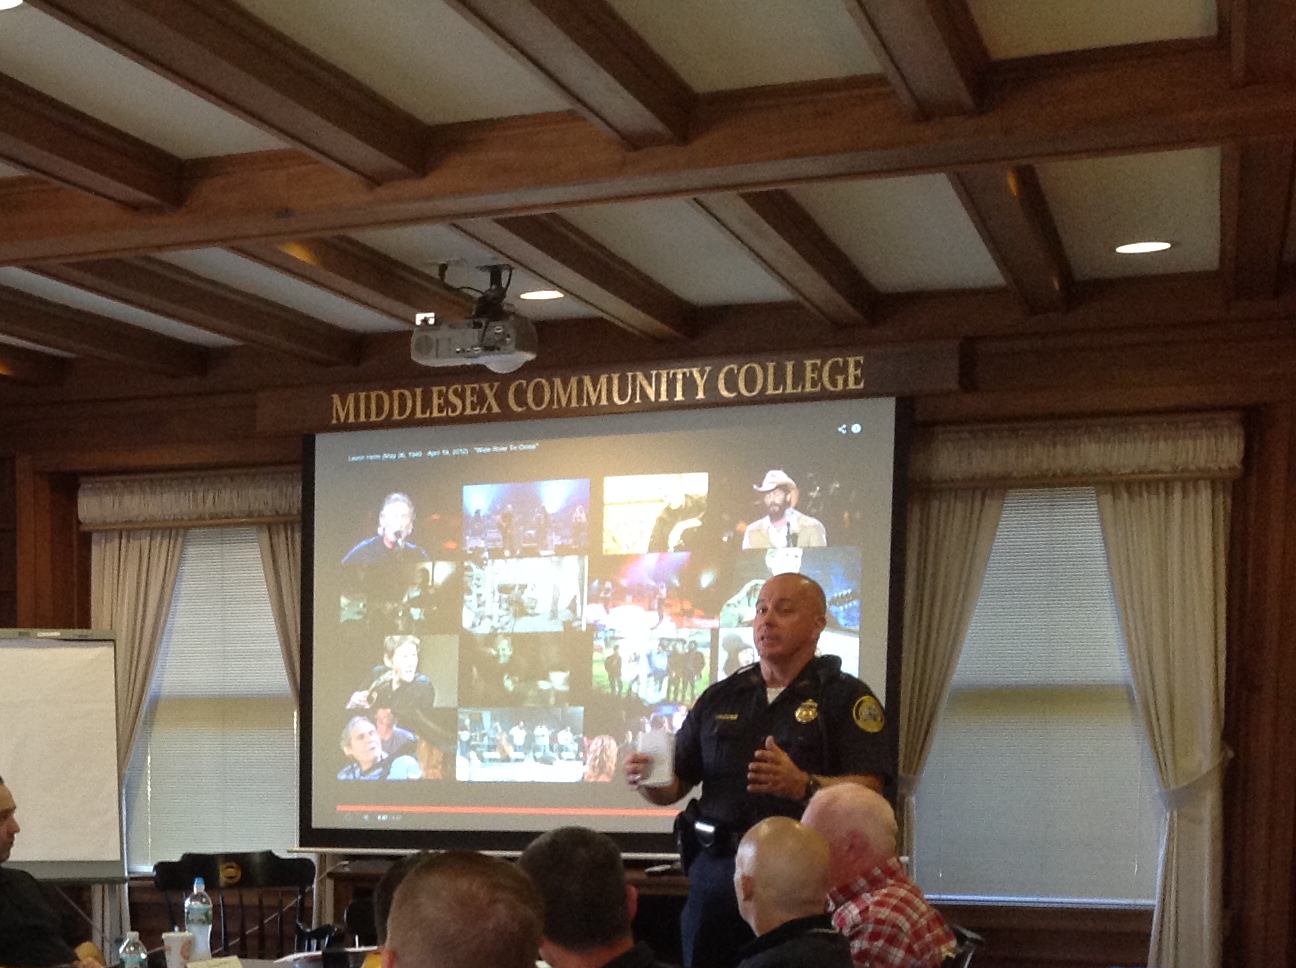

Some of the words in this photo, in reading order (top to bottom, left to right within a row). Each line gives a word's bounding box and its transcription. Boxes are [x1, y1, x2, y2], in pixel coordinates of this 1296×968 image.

[330, 381, 502, 425] MIDDLESEX
[507, 366, 712, 412] COMMUNITY
[717, 355, 866, 396] COLLEGE
